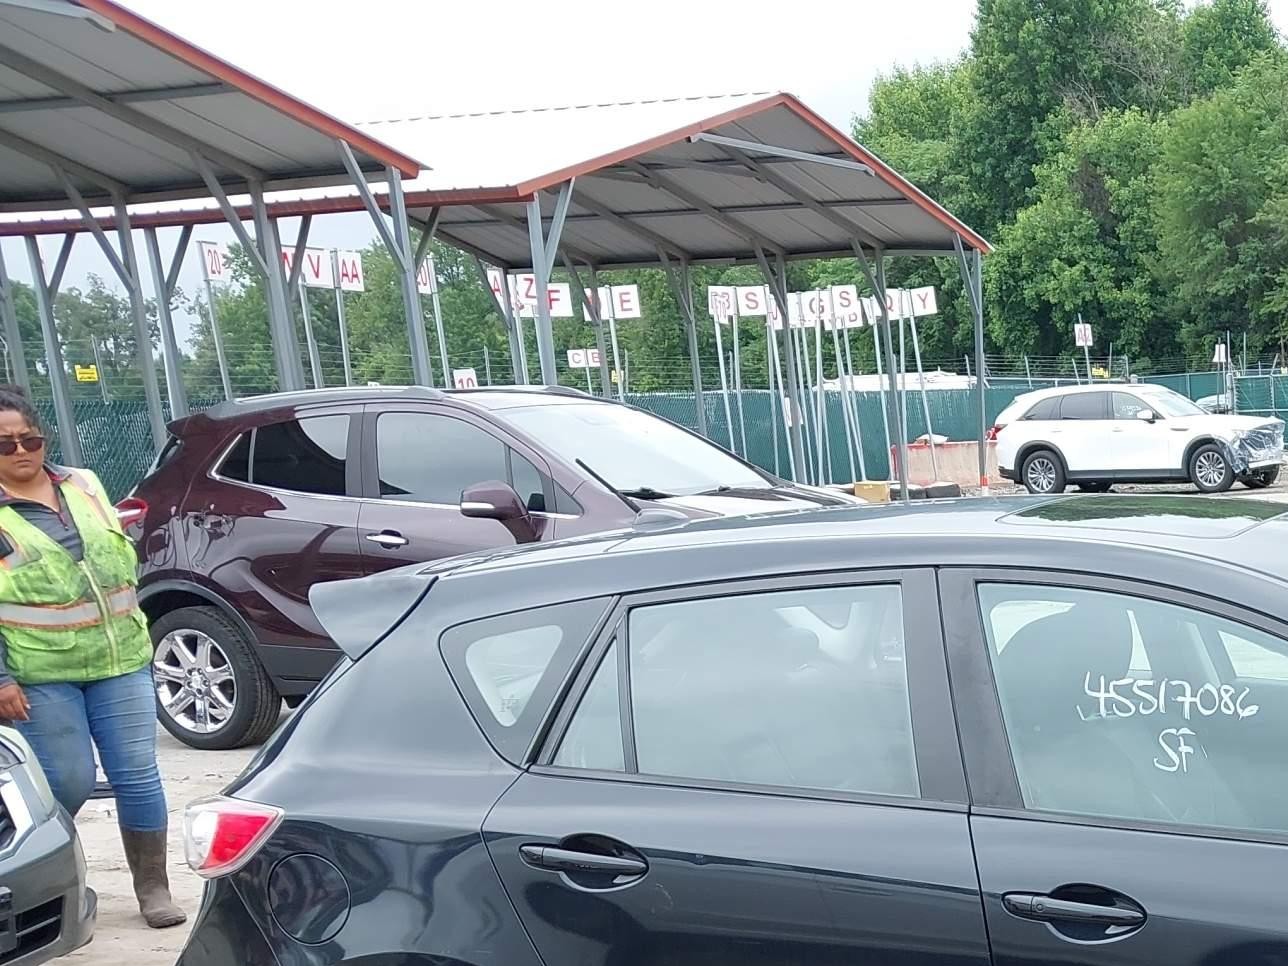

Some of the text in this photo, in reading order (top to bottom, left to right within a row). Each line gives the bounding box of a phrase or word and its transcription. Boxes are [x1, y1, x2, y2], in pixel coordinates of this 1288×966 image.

[307, 253, 320, 279] V
[341, 258, 361, 284] AA
[523, 277, 537, 299] Z
[547, 289, 561, 310] F
[618, 291, 633, 312] E
[745, 291, 759, 310] S
[808, 296, 825, 315] G
[839, 290, 852, 308] S
[916, 292, 929, 310] Y
[571, 352, 582, 364] C
[1084, 671, 1260, 720] 45517086
[1153, 727, 1196, 773] SF
